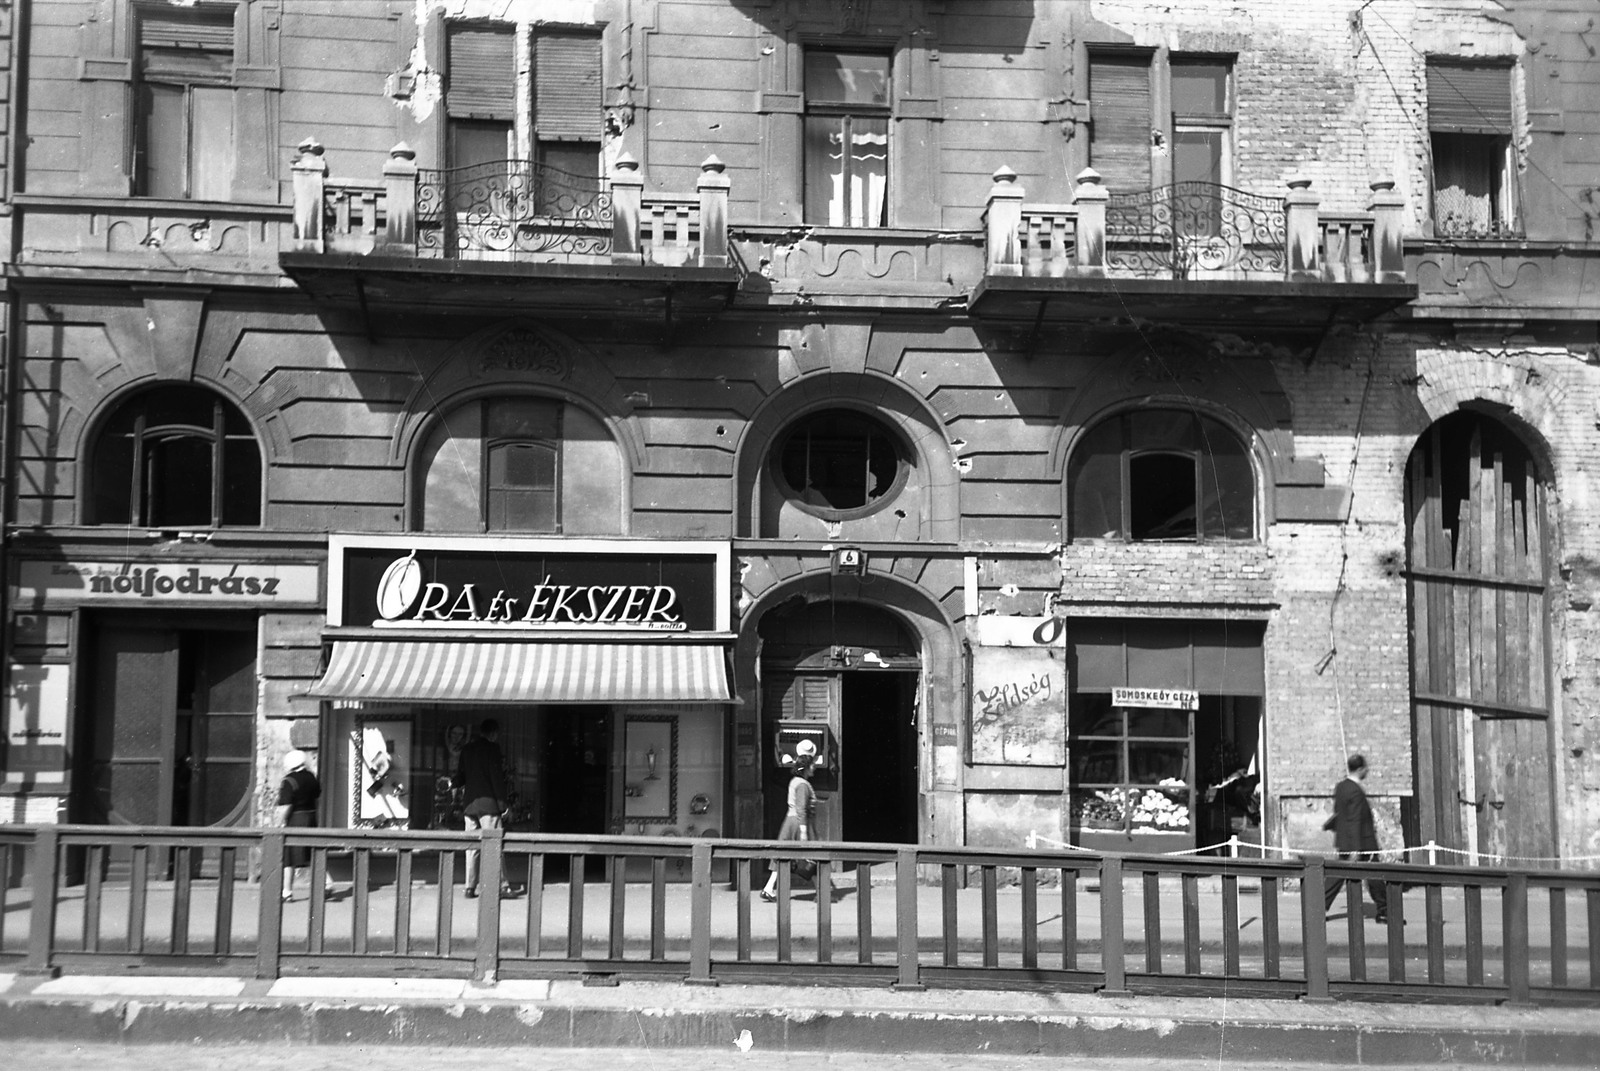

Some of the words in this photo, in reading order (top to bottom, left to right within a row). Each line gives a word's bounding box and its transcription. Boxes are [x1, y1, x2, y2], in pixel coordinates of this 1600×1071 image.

[846, 550, 853, 562] 6
[90, 564, 279, 596] nőifodrász
[521, 574, 679, 622] ÉKSZER
[973, 673, 1051, 733] Zöldség
